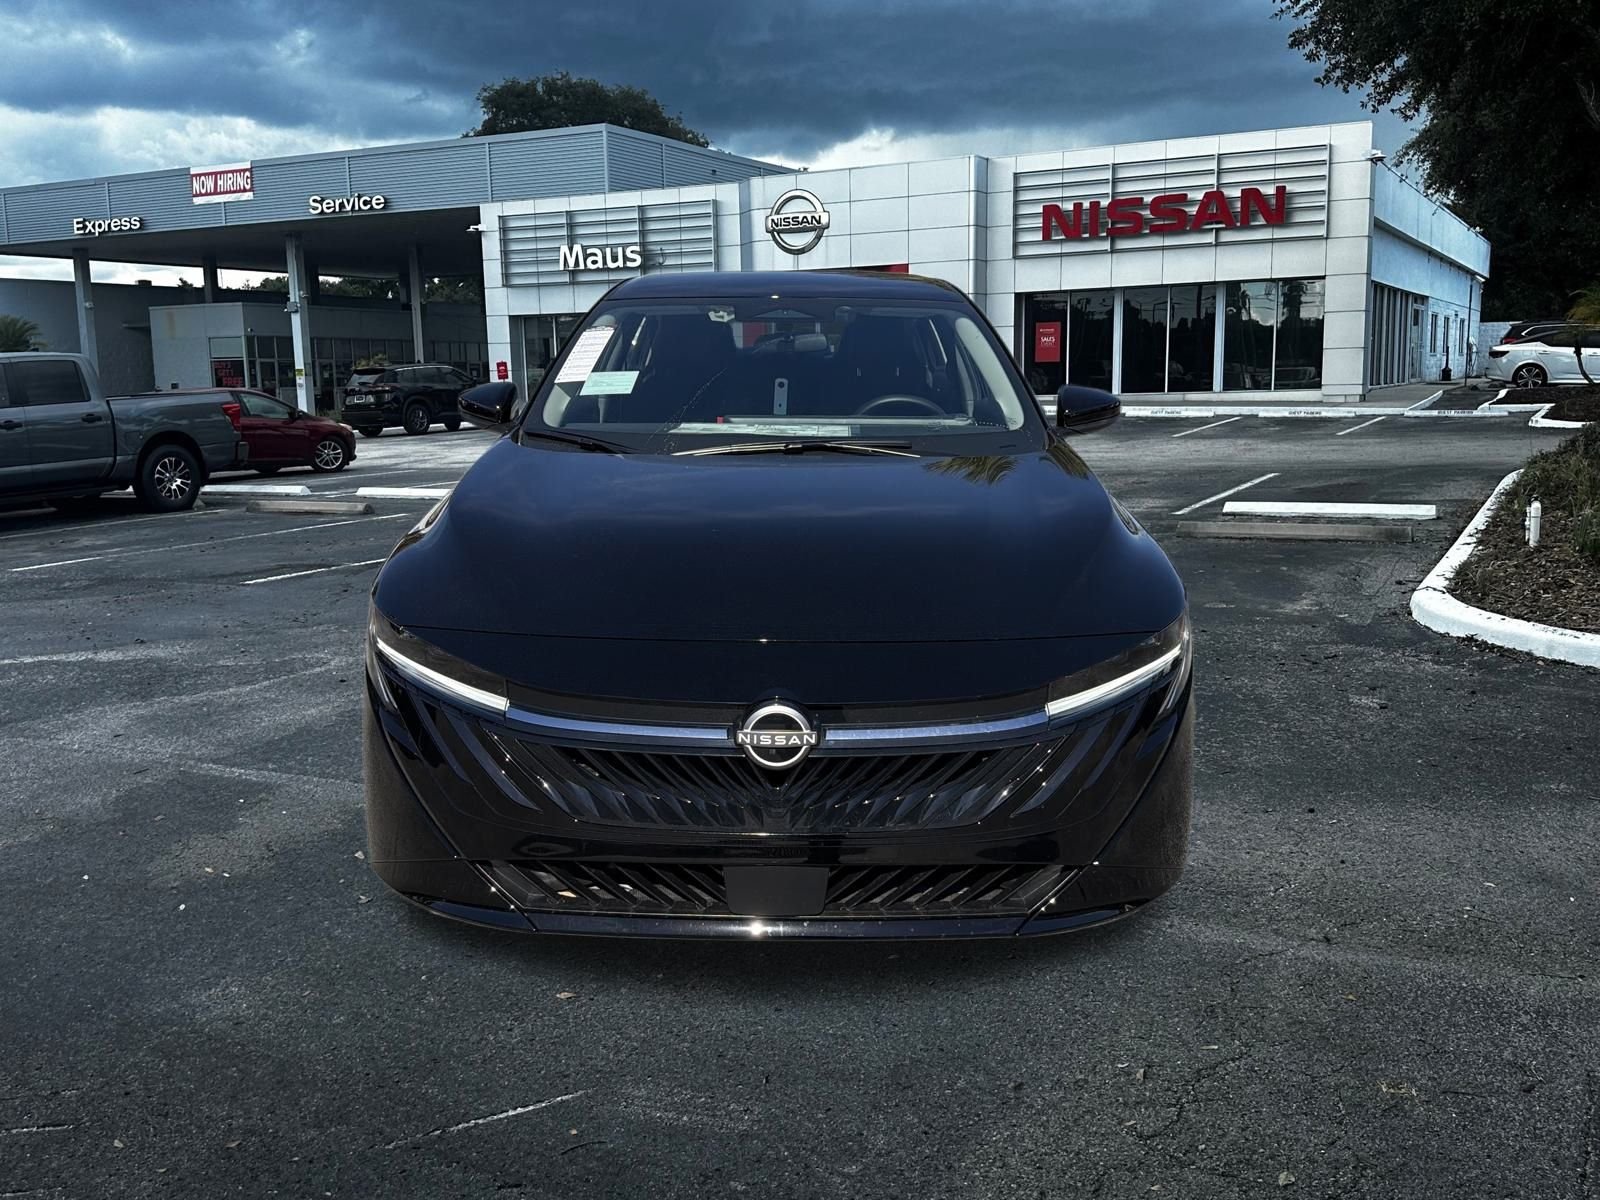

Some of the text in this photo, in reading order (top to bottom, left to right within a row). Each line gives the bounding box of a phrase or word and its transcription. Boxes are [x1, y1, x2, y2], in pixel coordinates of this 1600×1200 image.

[193, 171, 251, 194] NOW HIRING
[308, 193, 386, 215] Service
[1041, 185, 1287, 241] NISSAN
[73, 216, 141, 237] Express
[770, 215, 822, 229] NISSAN
[559, 244, 642, 270] Maus
[738, 733, 816, 745] NISSAN
